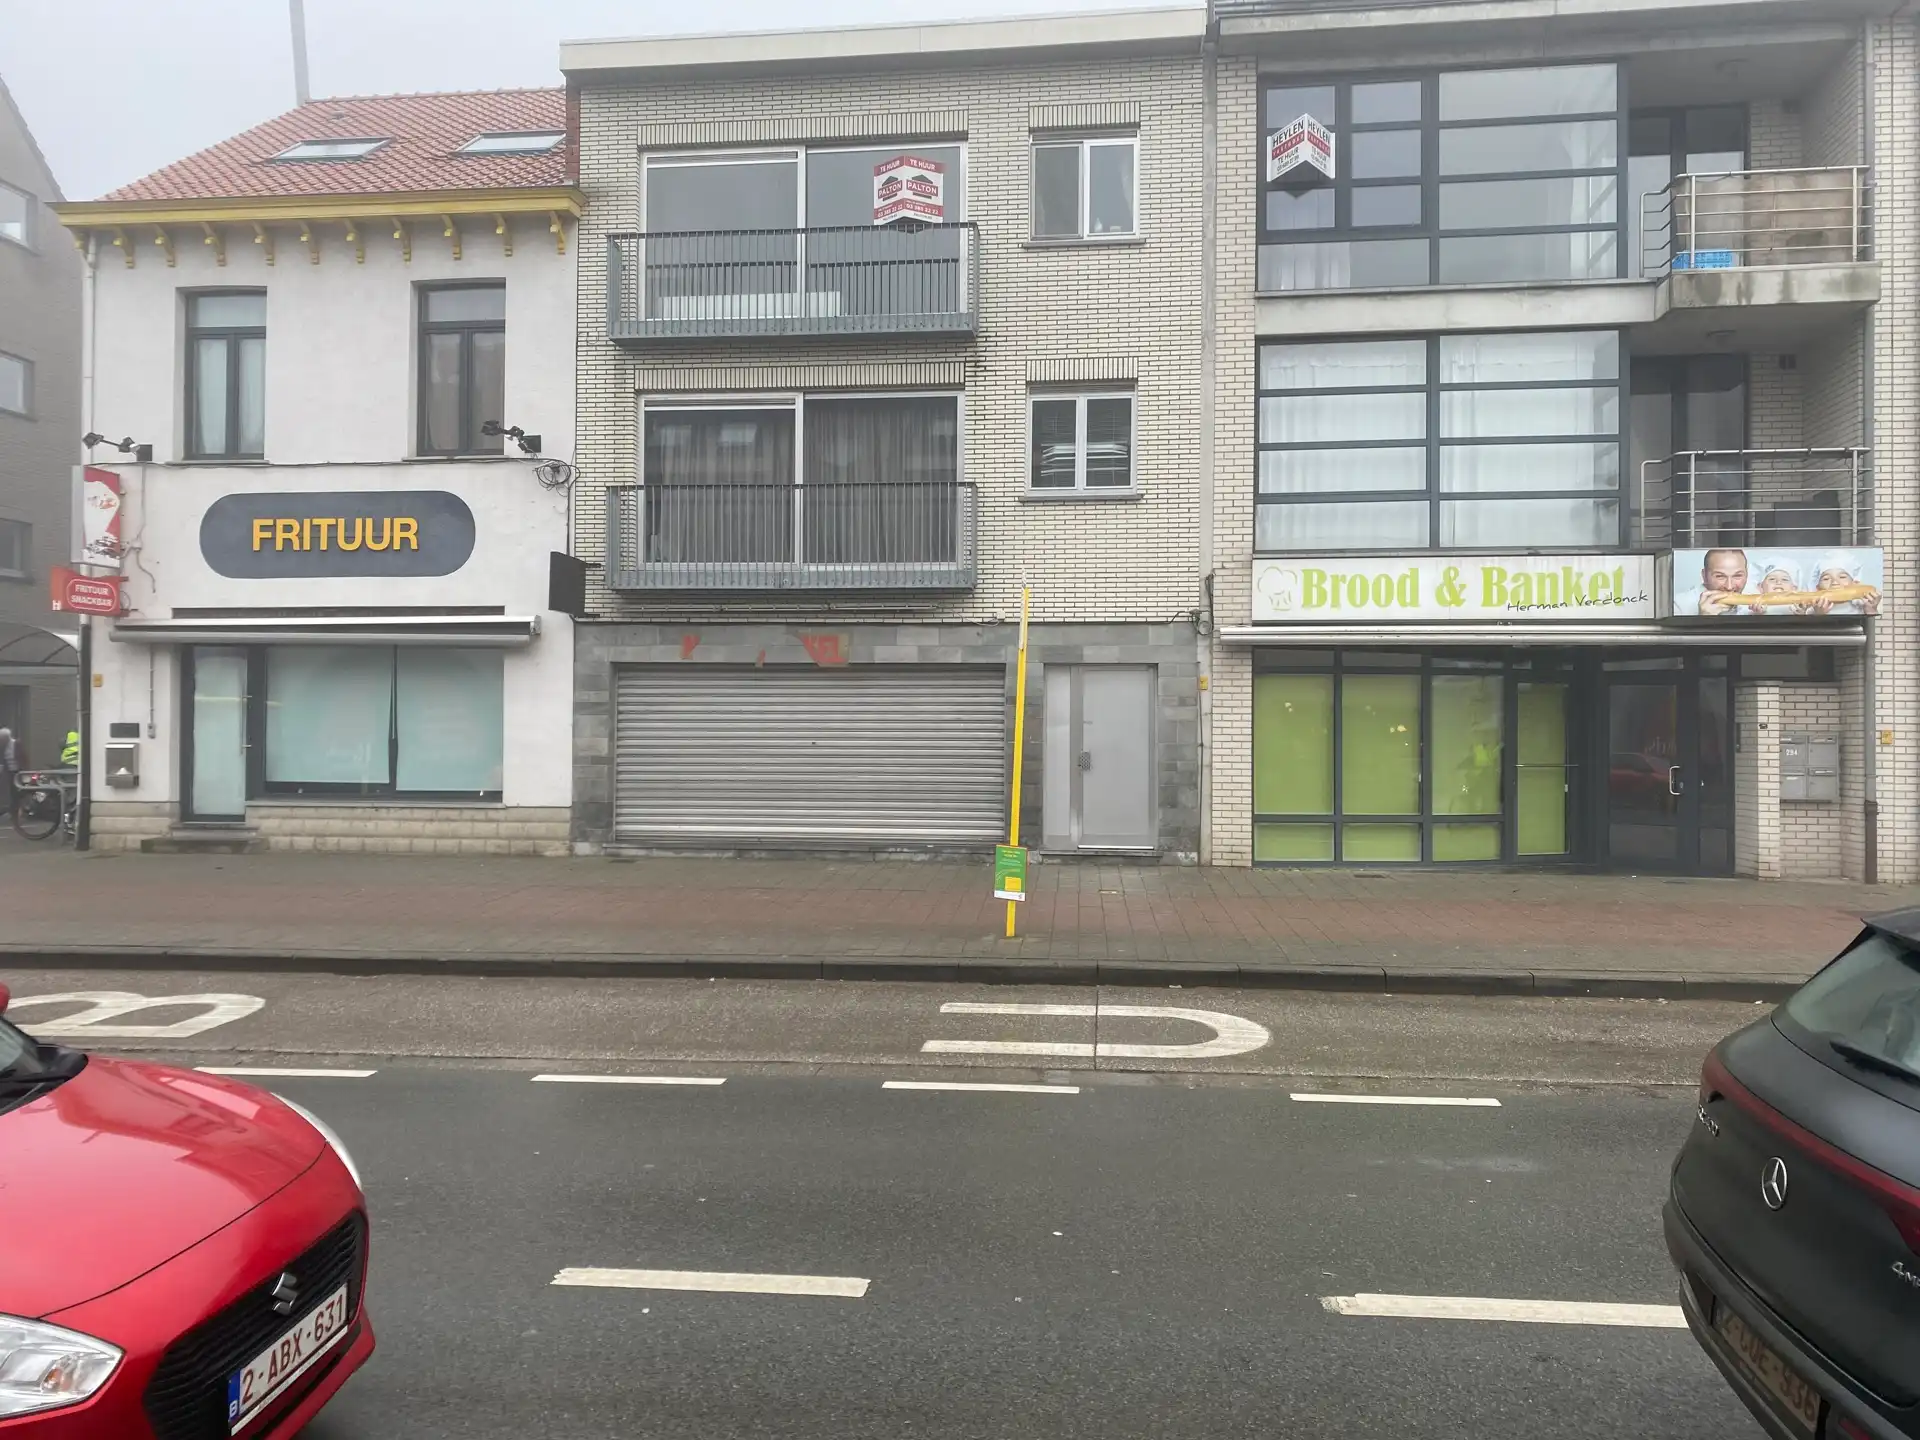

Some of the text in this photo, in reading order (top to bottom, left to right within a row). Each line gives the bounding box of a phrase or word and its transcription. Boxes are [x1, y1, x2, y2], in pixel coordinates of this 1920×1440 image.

[1272, 120, 1304, 147] HEYLEN
[1308, 120, 1330, 144] HEYLEN
[886, 160, 900, 170] HUUR
[918, 162, 936, 170] HUUR
[878, 182, 902, 197] PALTON
[907, 182, 937, 194] PALTON
[252, 518, 418, 551] FRITUUR
[75, 584, 109, 596] FRITUUR
[1300, 566, 1625, 609] Brood & Banket
[71, 594, 112, 606] SNACKBAR
[1507, 590, 1648, 612] Herman Verdonck
[241, 1294, 343, 1406] 2-ABX-631
[229, 1400, 237, 1418] B
